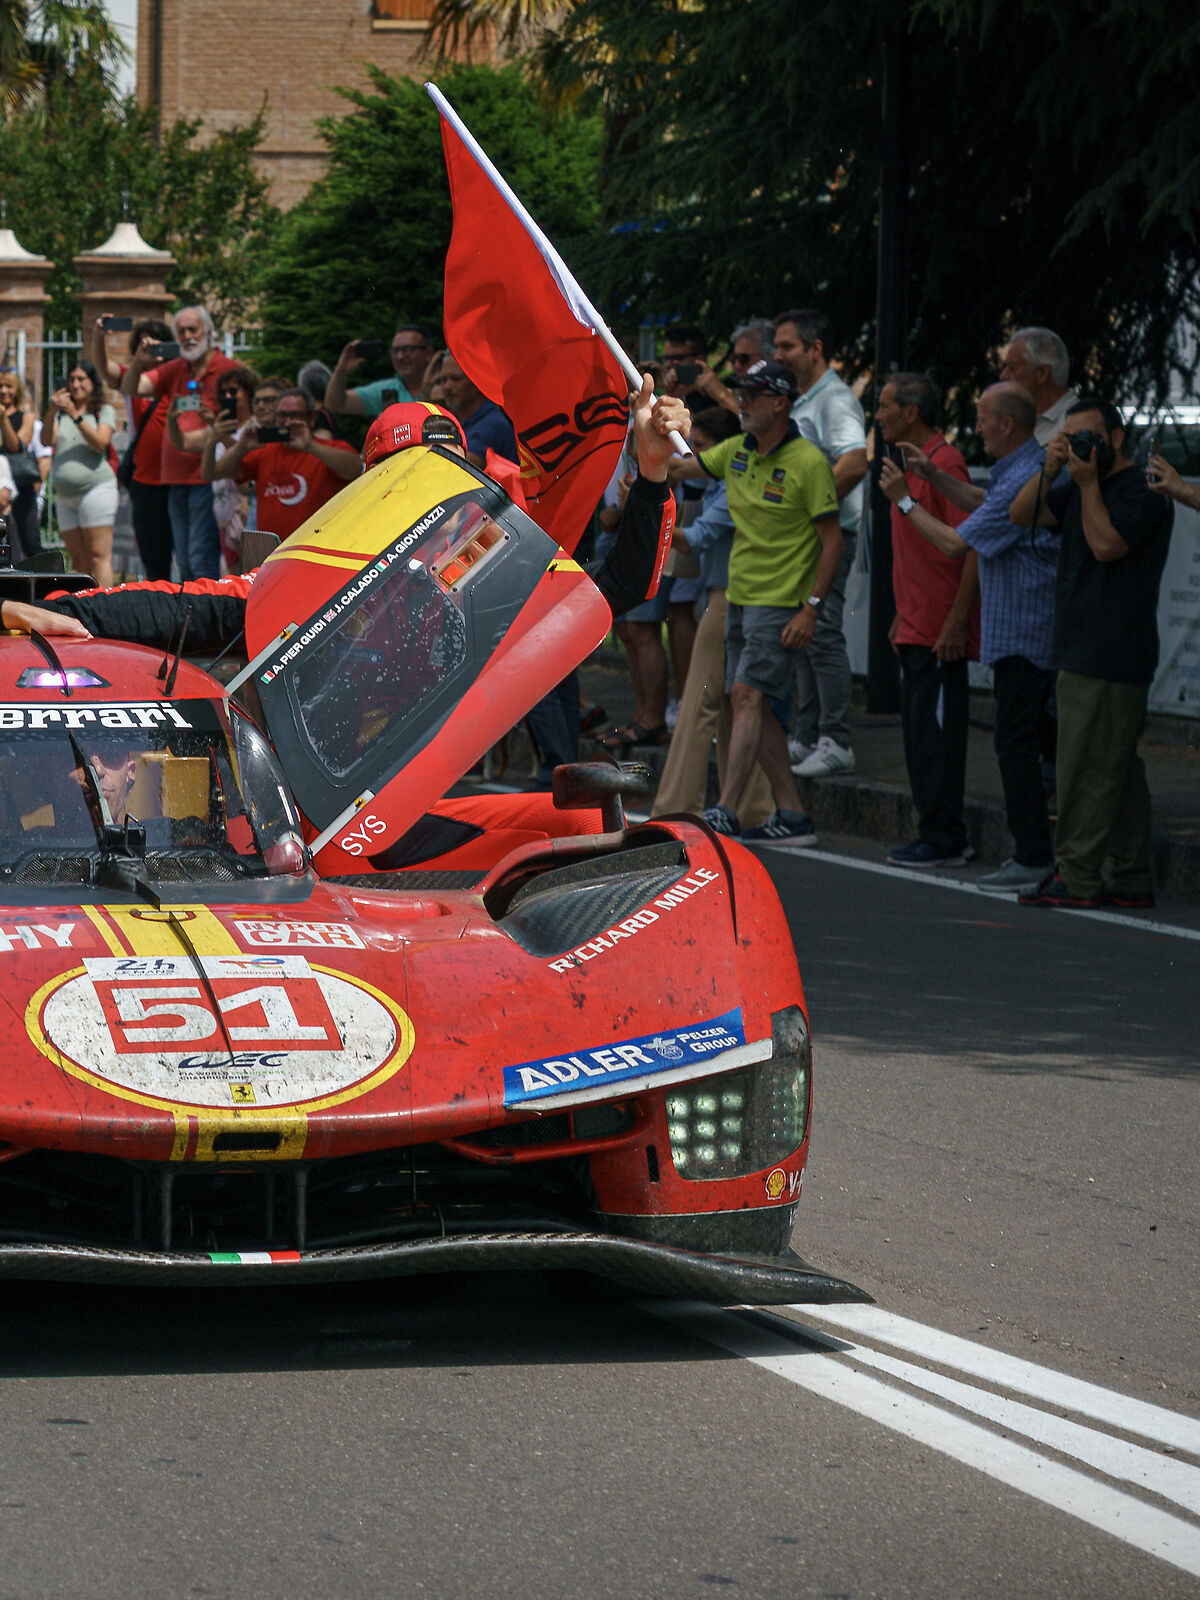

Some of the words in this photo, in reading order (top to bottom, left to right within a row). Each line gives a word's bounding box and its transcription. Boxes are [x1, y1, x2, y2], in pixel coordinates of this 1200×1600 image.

[280, 643, 304, 664] PIER
[300, 619, 327, 645] GUIDI
[341, 568, 379, 606] CALADO
[394, 506, 446, 553] GIOVINAZZI
[341, 815, 387, 857] SYS
[653, 867, 719, 911] MILLE
[242, 923, 347, 932] HYPER
[249, 931, 356, 946] CAR
[111, 985, 329, 1044] 51
[677, 1027, 728, 1043] PELZER
[689, 1036, 738, 1053] GROUP
[178, 1053, 289, 1068] WEC
[515, 1045, 655, 1092] ADLER
